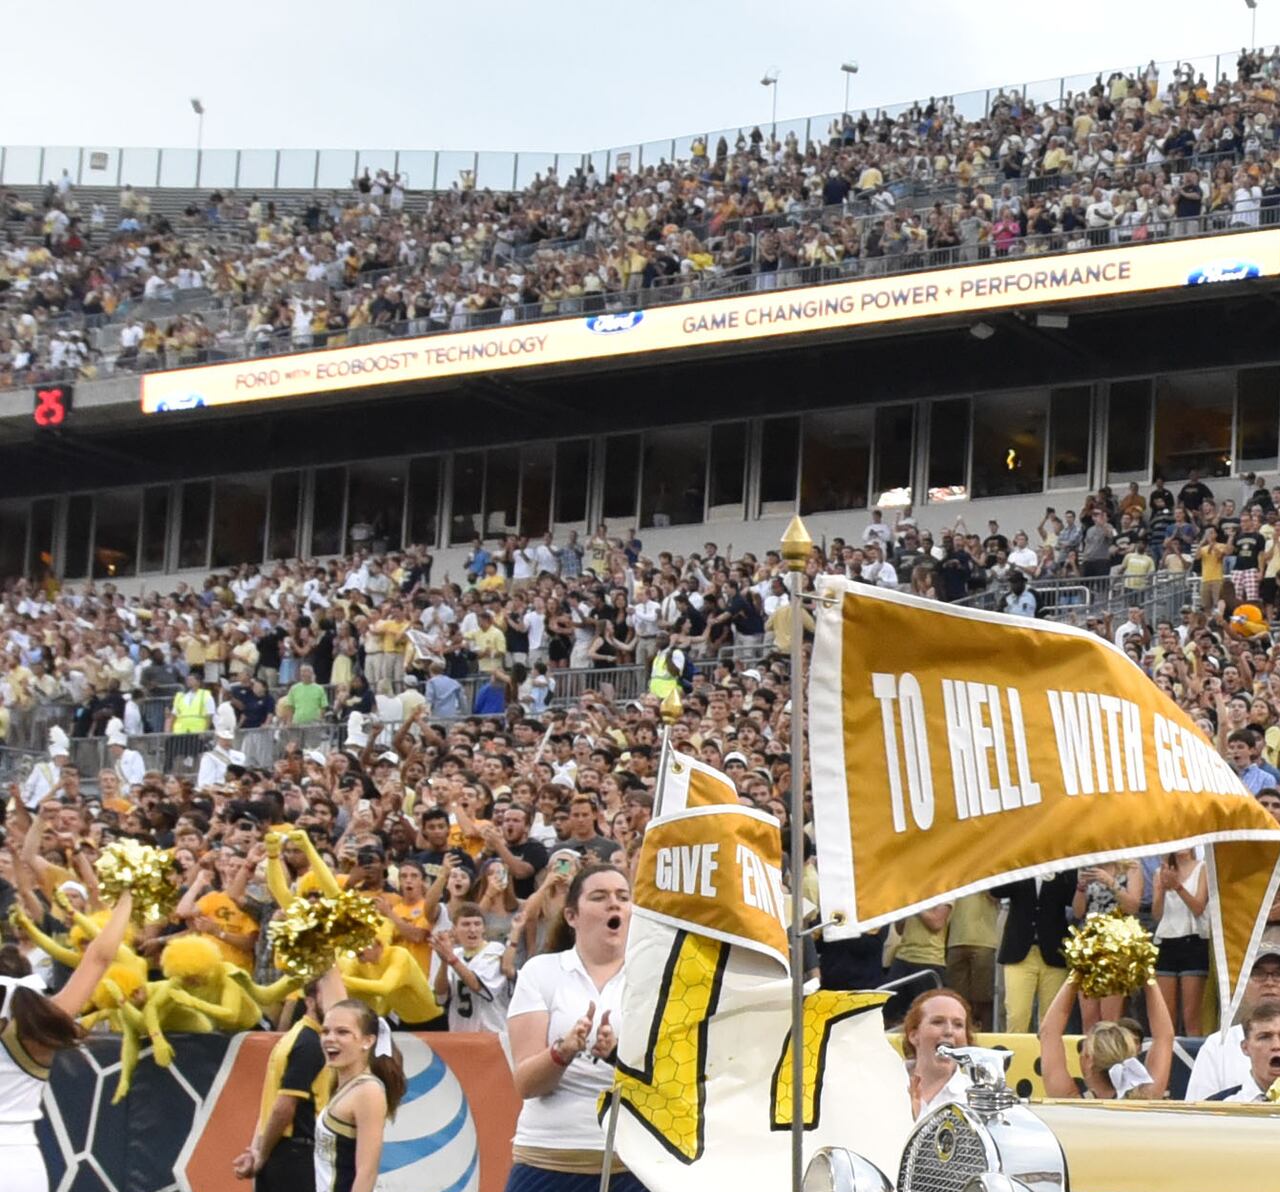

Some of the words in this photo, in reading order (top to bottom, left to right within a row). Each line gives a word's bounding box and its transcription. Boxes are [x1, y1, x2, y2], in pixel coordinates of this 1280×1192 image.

[682, 310, 740, 334] GAME
[744, 295, 855, 327] CHANGING
[860, 284, 939, 312] POWER
[959, 260, 1132, 299] PERFORMANCE
[235, 368, 281, 391] FORD
[425, 334, 549, 366] TECHNOLOGY
[871, 672, 935, 833] TO
[941, 678, 1042, 820] HELL
[1046, 689, 1147, 796] WITH
[655, 843, 720, 898] GIVE
